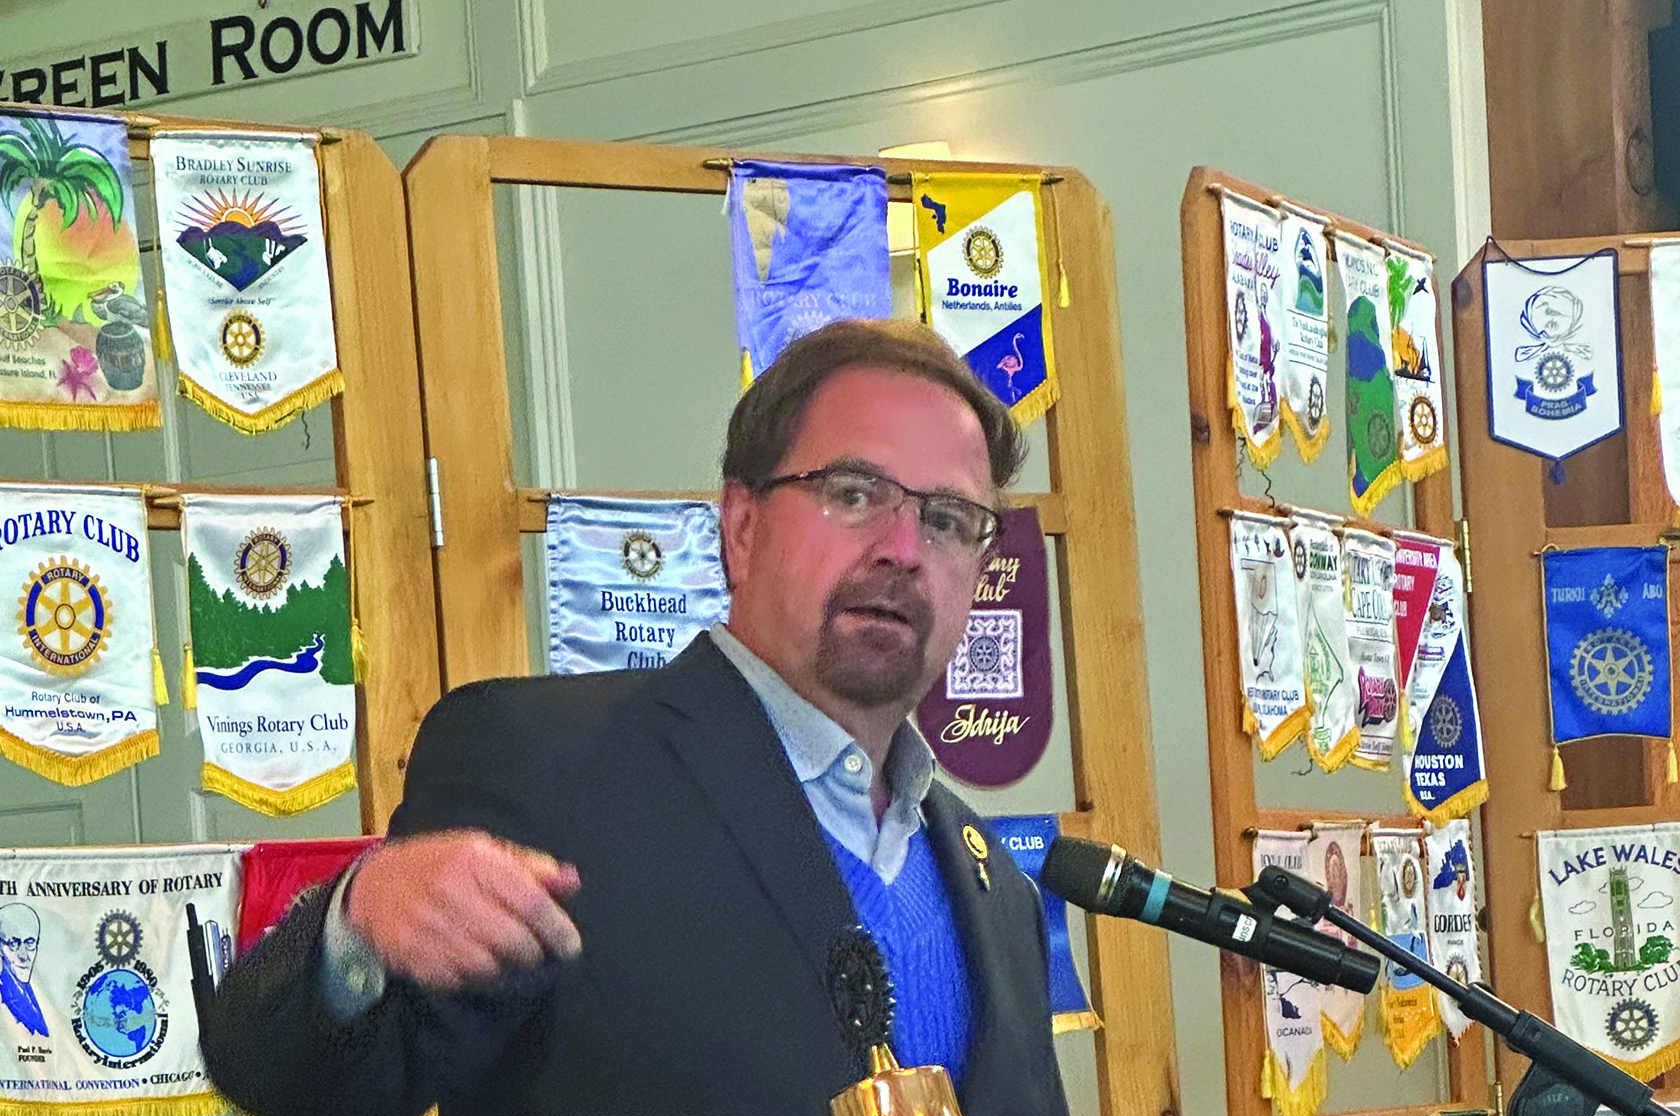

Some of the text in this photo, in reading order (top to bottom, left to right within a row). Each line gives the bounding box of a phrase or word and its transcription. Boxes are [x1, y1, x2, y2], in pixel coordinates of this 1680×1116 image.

[0, 2, 405, 106] REEN ROOM
[200, 174, 268, 186] ROTARY CLUB
[946, 278, 1019, 299] Bonaire
[942, 301, 1022, 312] Netherlands, Antilles
[219, 371, 277, 382] CLEVELAND
[0, 510, 140, 563] OTARY CLUB
[46, 569, 84, 584] ROTARY
[974, 573, 1010, 602] lub
[1551, 587, 1586, 602] TURKU
[601, 591, 687, 614] Buckhead
[615, 621, 675, 648] Rotary
[31, 635, 100, 666] INTERNATIONAL
[31, 691, 100, 704] Rotary Club of
[207, 713, 349, 737] Vinings Rotary Club
[221, 742, 284, 754] GEORGIA,
[1415, 755, 1464, 770] HOUSTON
[1415, 772, 1446, 787] TEXAS
[1010, 835, 1043, 850] CLUB
[1549, 847, 1607, 886] LAKE
[27, 880, 133, 898] ANNIVERSARY
[139, 879, 159, 895] OF
[163, 872, 223, 892] ROTARY
[1574, 921, 1675, 941] FLORIDA
[1561, 958, 1680, 998] ROTARY CLU
[76, 1078, 140, 1091] CONVENTION
[150, 1071, 194, 1085] CHICAGO
